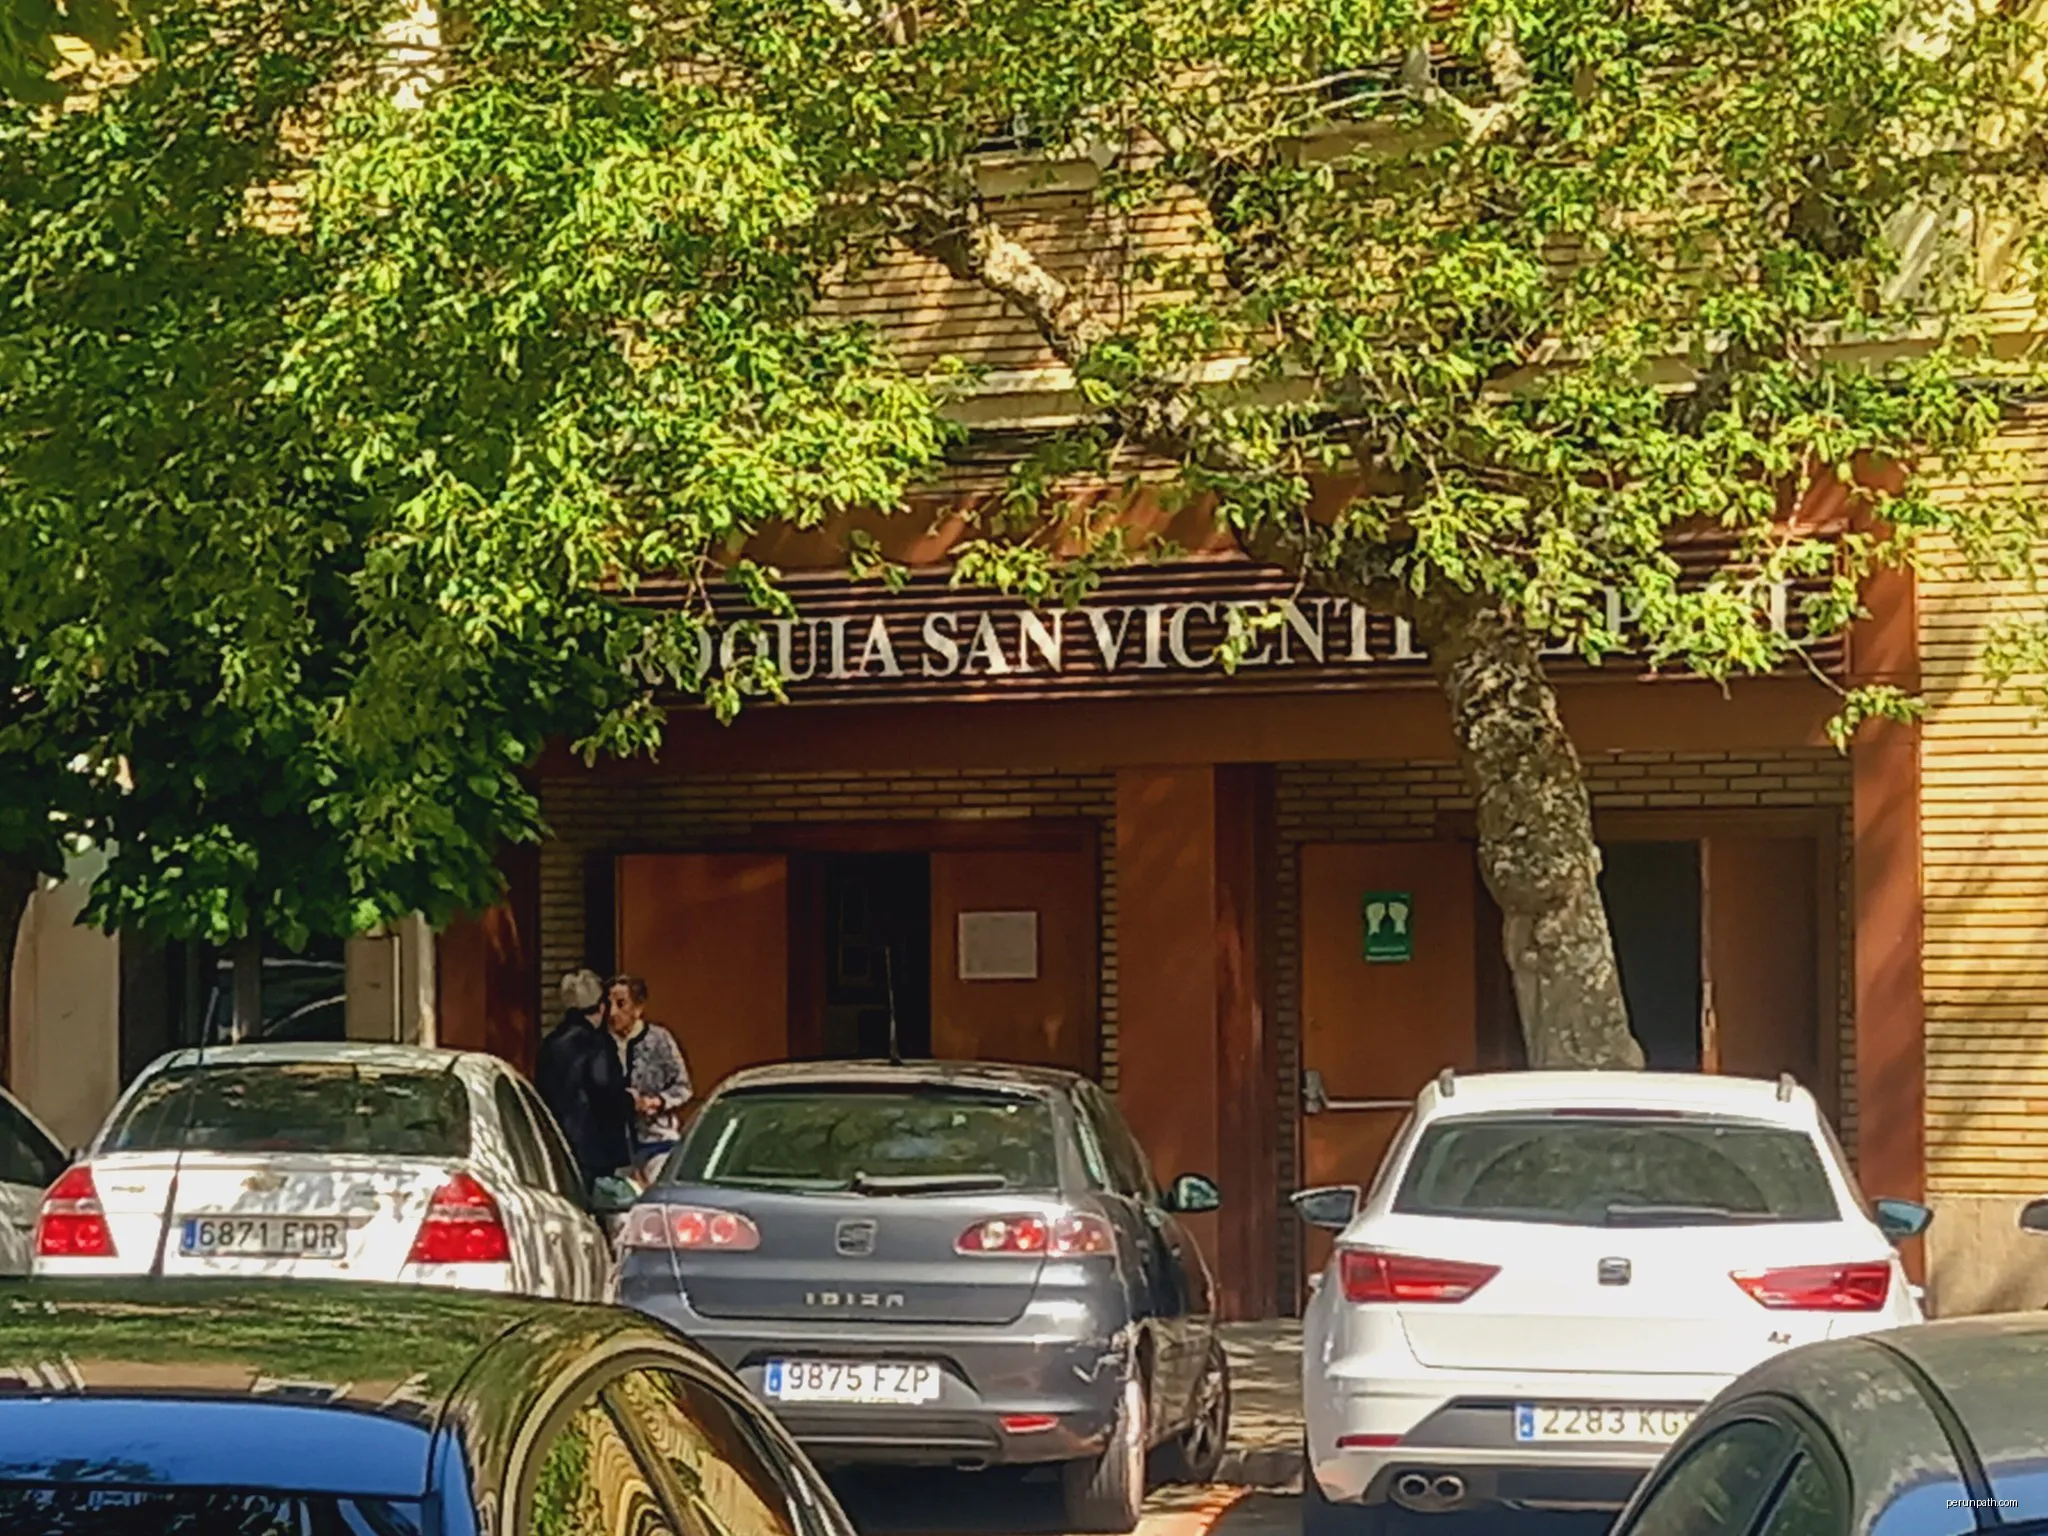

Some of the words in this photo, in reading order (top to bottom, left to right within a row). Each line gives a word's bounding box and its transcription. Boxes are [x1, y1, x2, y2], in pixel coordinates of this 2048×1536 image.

[922, 609, 1067, 677] SAN
[200, 1222, 268, 1247] 6871
[788, 1362, 862, 1392] 9875
[874, 1364, 929, 1394] FZP
[1542, 1405, 1625, 1435] 2283
